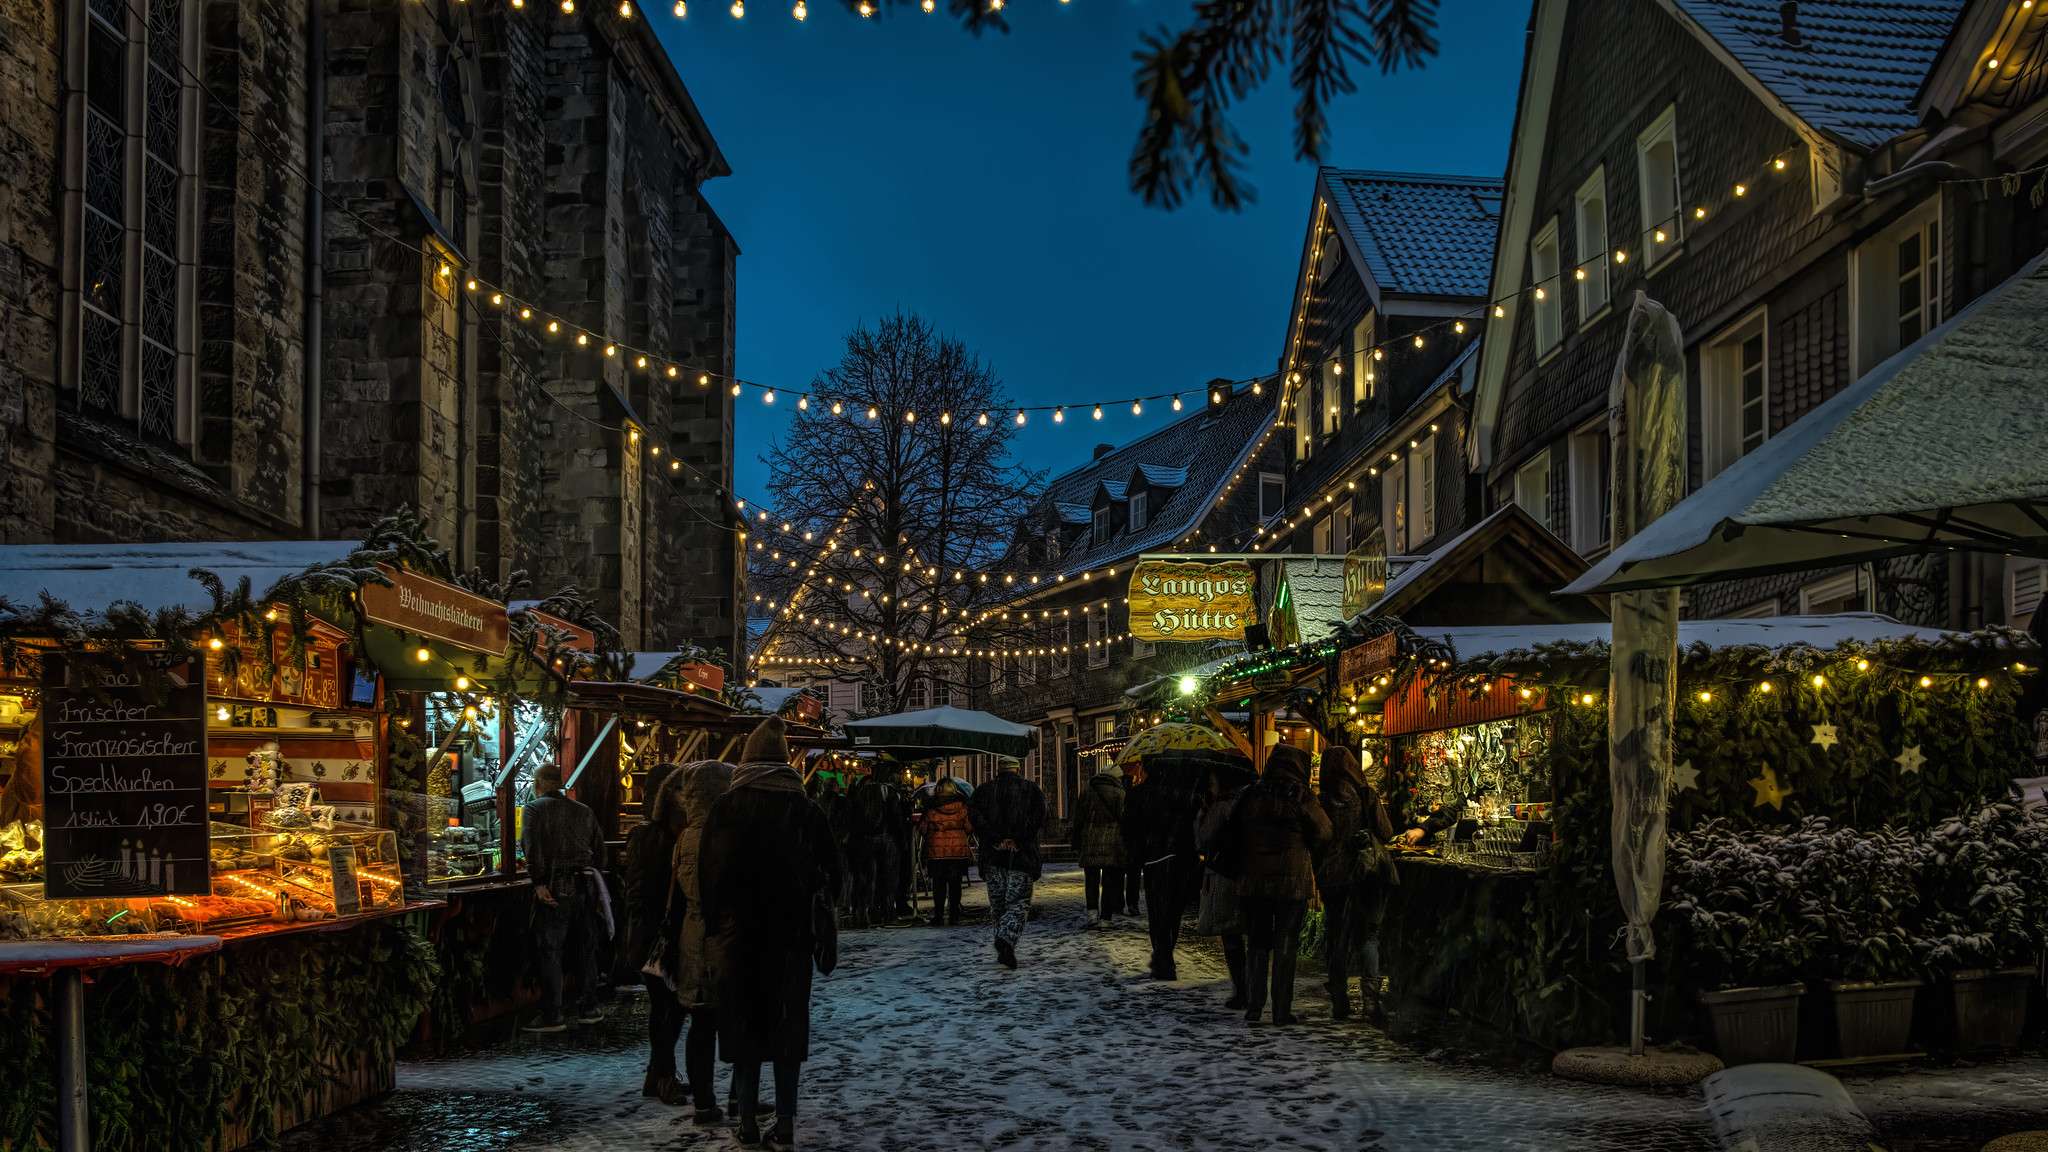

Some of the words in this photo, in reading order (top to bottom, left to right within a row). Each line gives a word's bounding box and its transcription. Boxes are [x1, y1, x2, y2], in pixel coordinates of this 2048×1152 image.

[1141, 574, 1247, 602] Langos
[399, 585, 483, 632] Weihnachtsbäckerei
[1152, 608, 1239, 635] Hütte
[58, 698, 156, 722] Frischer
[49, 763, 174, 811] Speckkuchen
